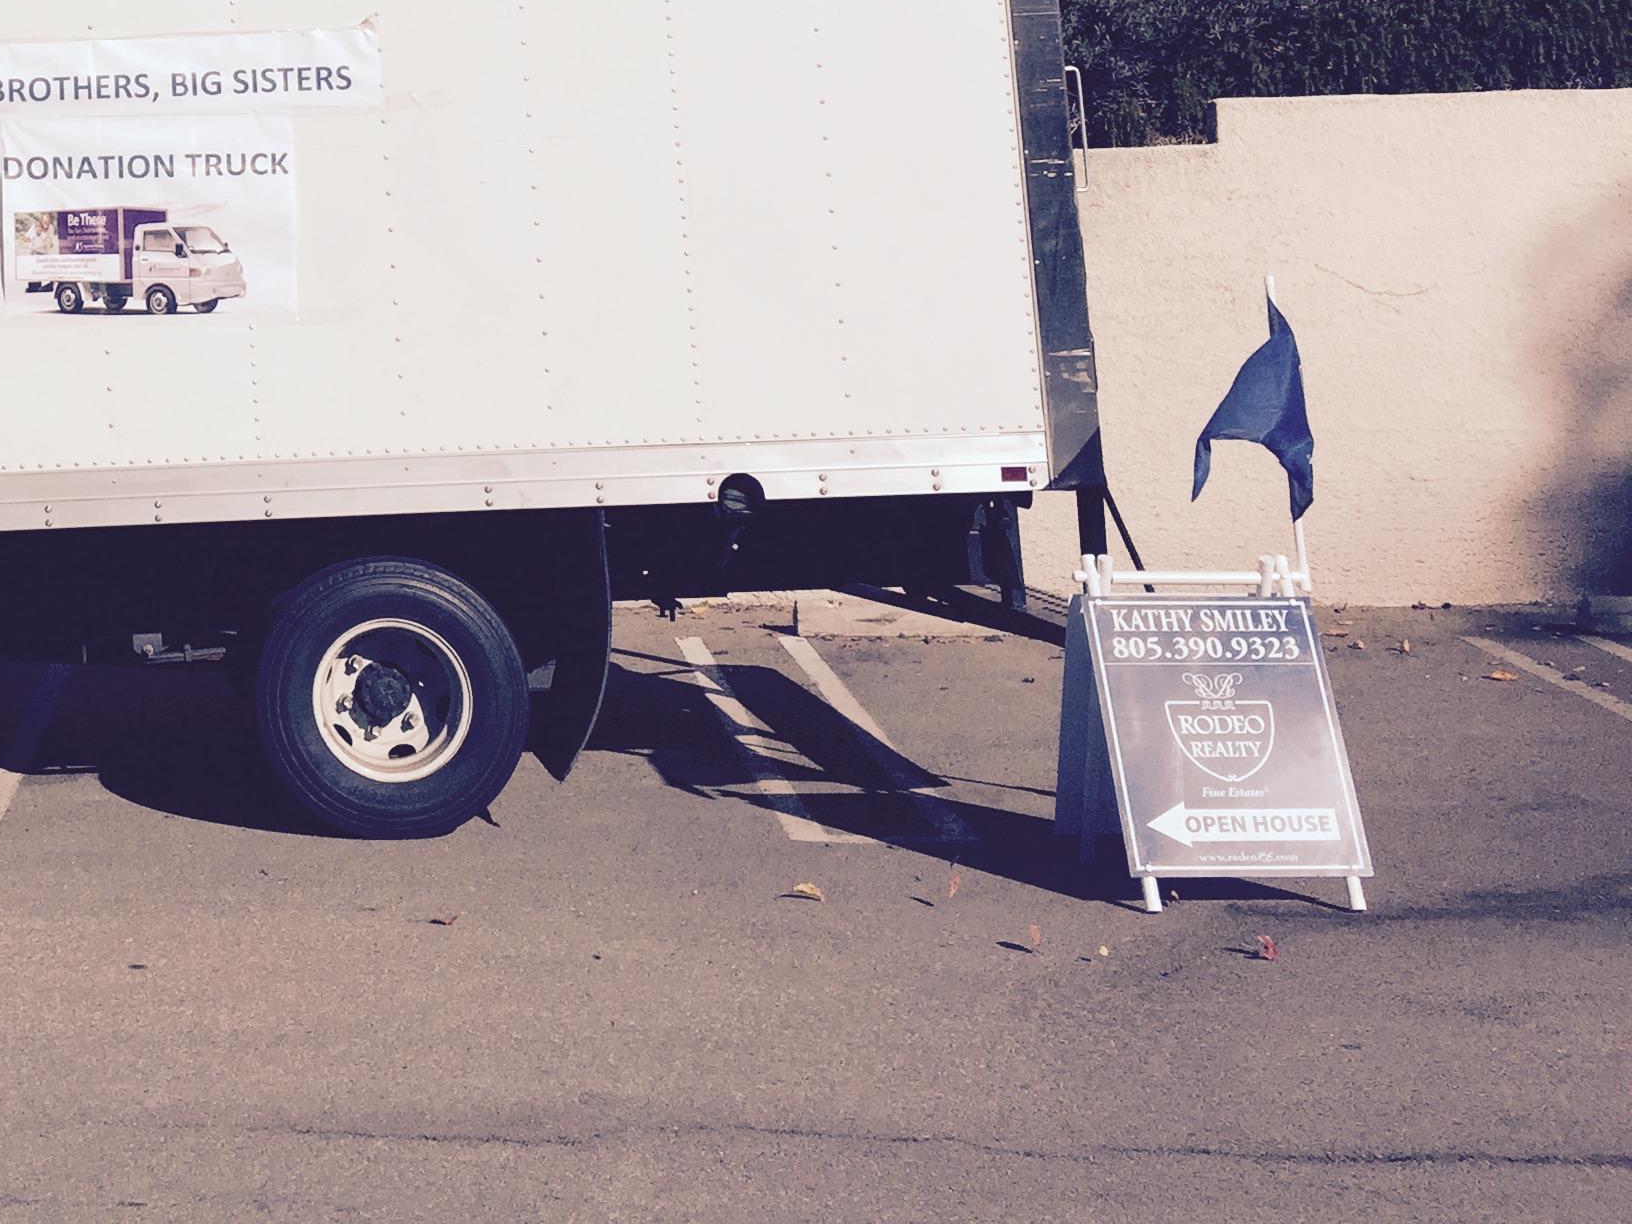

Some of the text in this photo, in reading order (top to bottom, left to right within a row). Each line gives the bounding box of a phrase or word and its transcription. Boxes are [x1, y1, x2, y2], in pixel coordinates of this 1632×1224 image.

[171, 70, 222, 97] BIG
[232, 65, 353, 94] SISTERS
[3, 152, 290, 181] DONATION TRUCK
[1109, 608, 1289, 633] KATHY SMILEY
[1112, 636, 1300, 660] 805.390.9323
[1178, 715, 1265, 735] RODEO
[1190, 741, 1262, 758] REALTY
[1202, 786, 1226, 798] Fine
[1184, 815, 1332, 833] OPEN HOUSE
